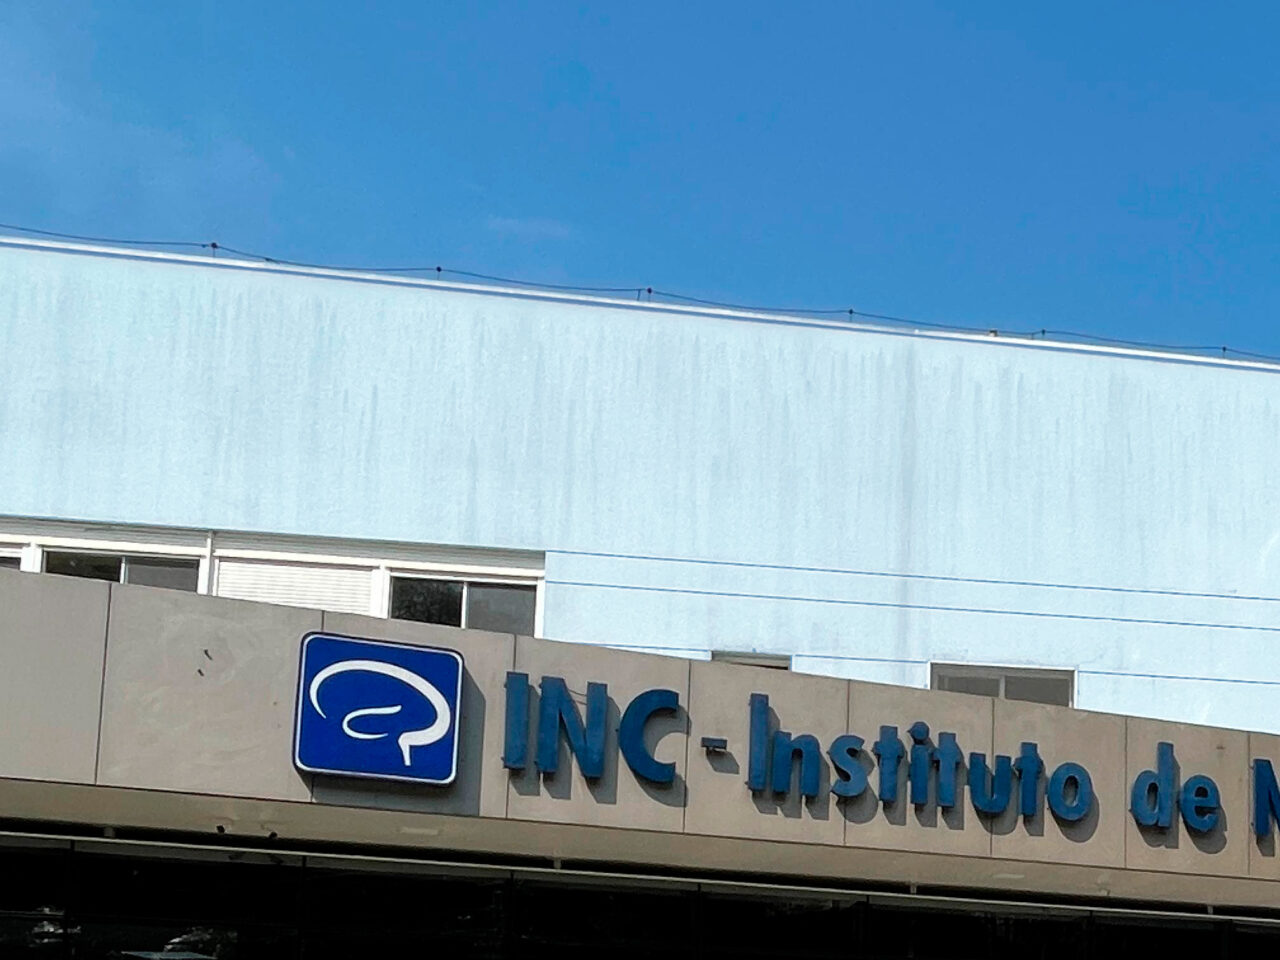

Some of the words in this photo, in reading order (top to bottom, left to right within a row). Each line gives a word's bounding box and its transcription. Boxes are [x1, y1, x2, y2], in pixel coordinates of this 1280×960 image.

[504, 671, 680, 784] INC
[748, 693, 1091, 823] Instituto
[1130, 742, 1221, 832] de
